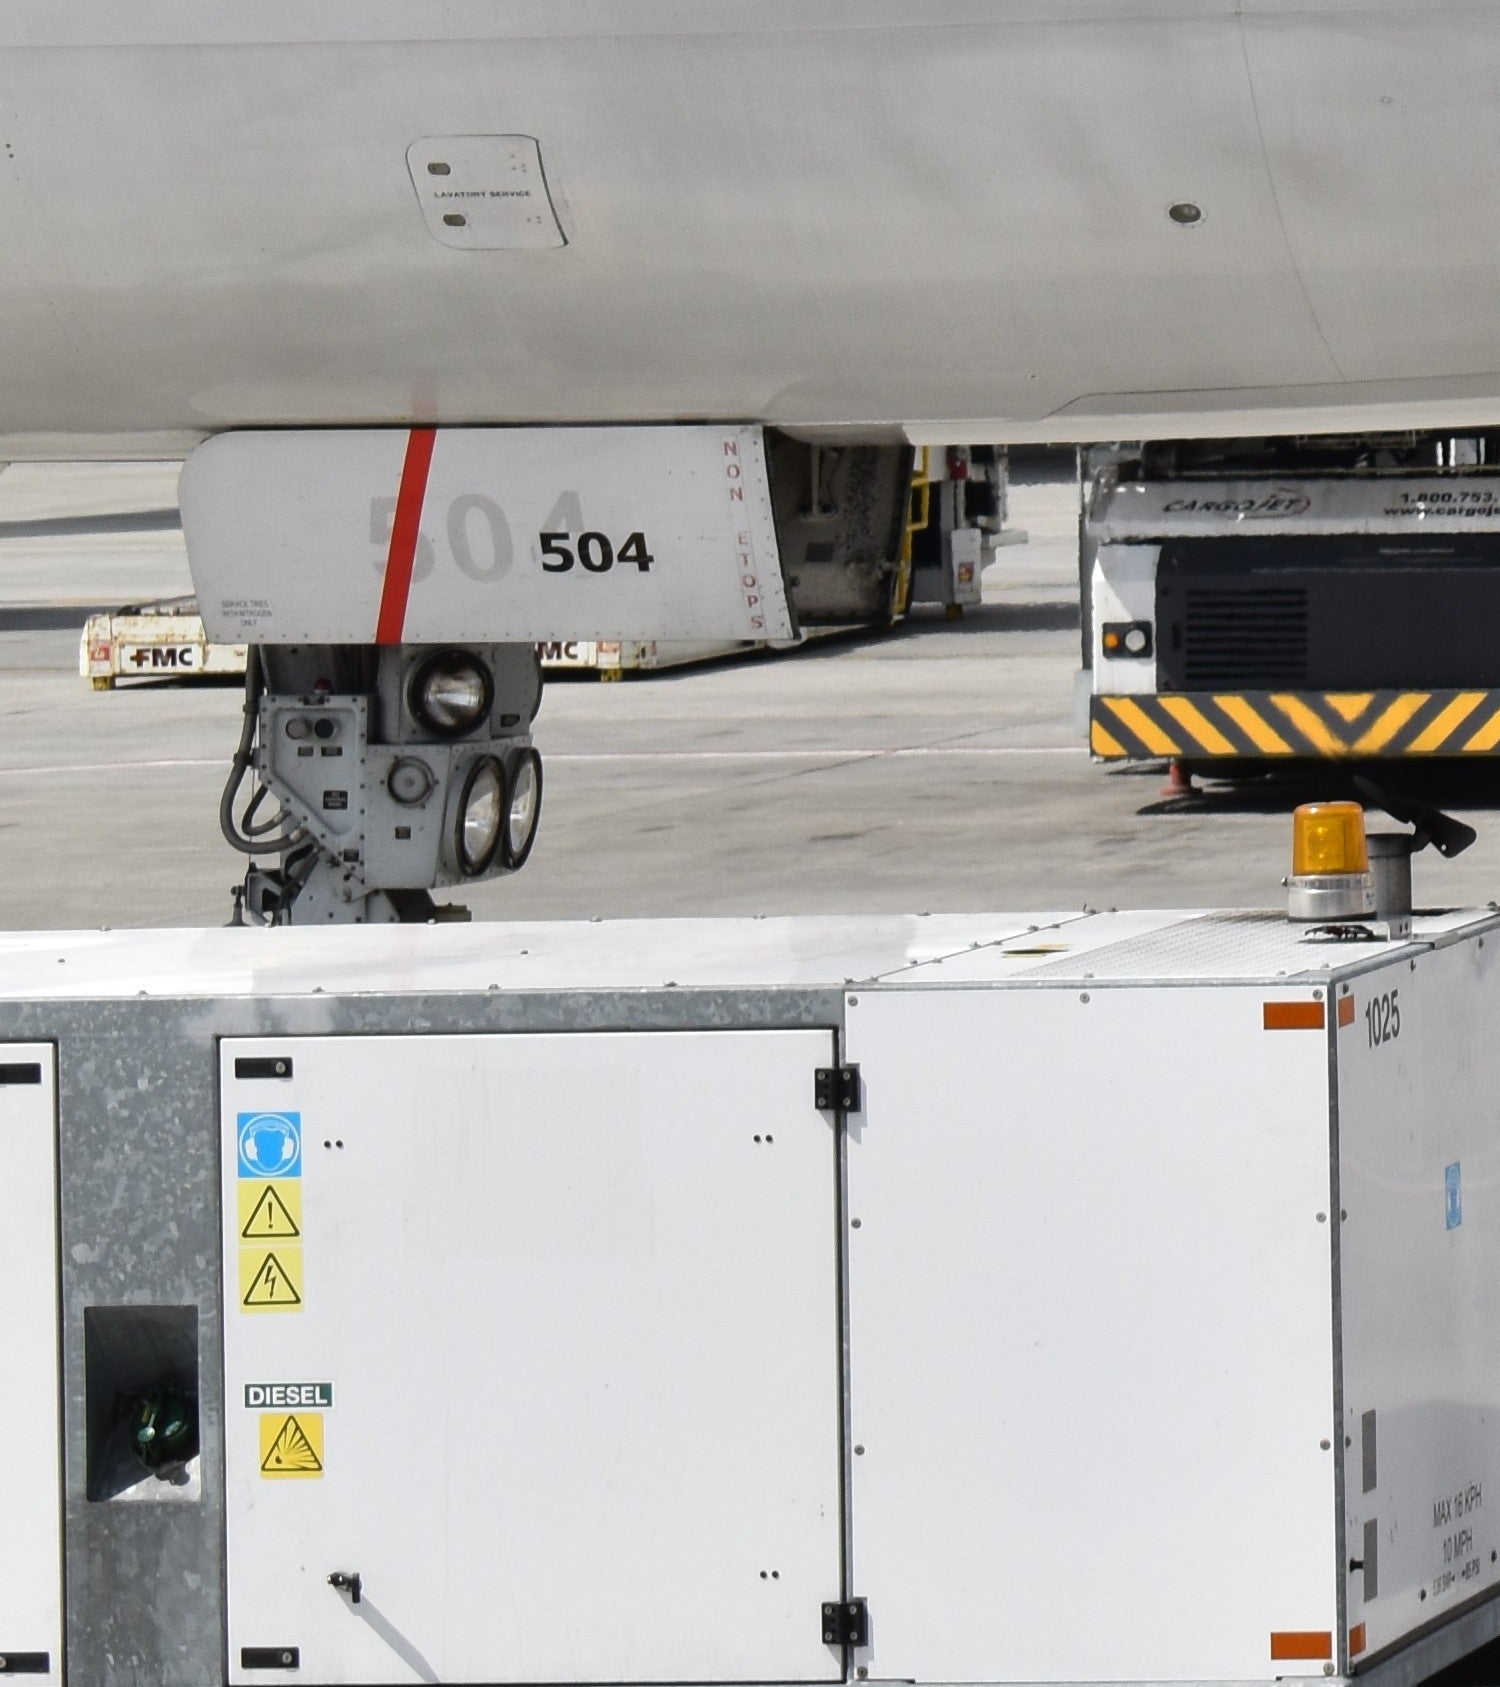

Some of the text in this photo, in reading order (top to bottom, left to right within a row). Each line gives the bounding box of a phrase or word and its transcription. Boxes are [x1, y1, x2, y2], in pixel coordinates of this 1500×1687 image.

[1162, 497, 1304, 513] CARGOJET
[539, 531, 655, 573] 504
[130, 648, 194, 667] FMC
[1365, 988, 1401, 1049] 1025
[248, 1385, 329, 1406] DIESEL
[1433, 1497, 1452, 1528] MAX
[1464, 1481, 1482, 1513] KPH
[1442, 1526, 1473, 1564] 10 MPH
